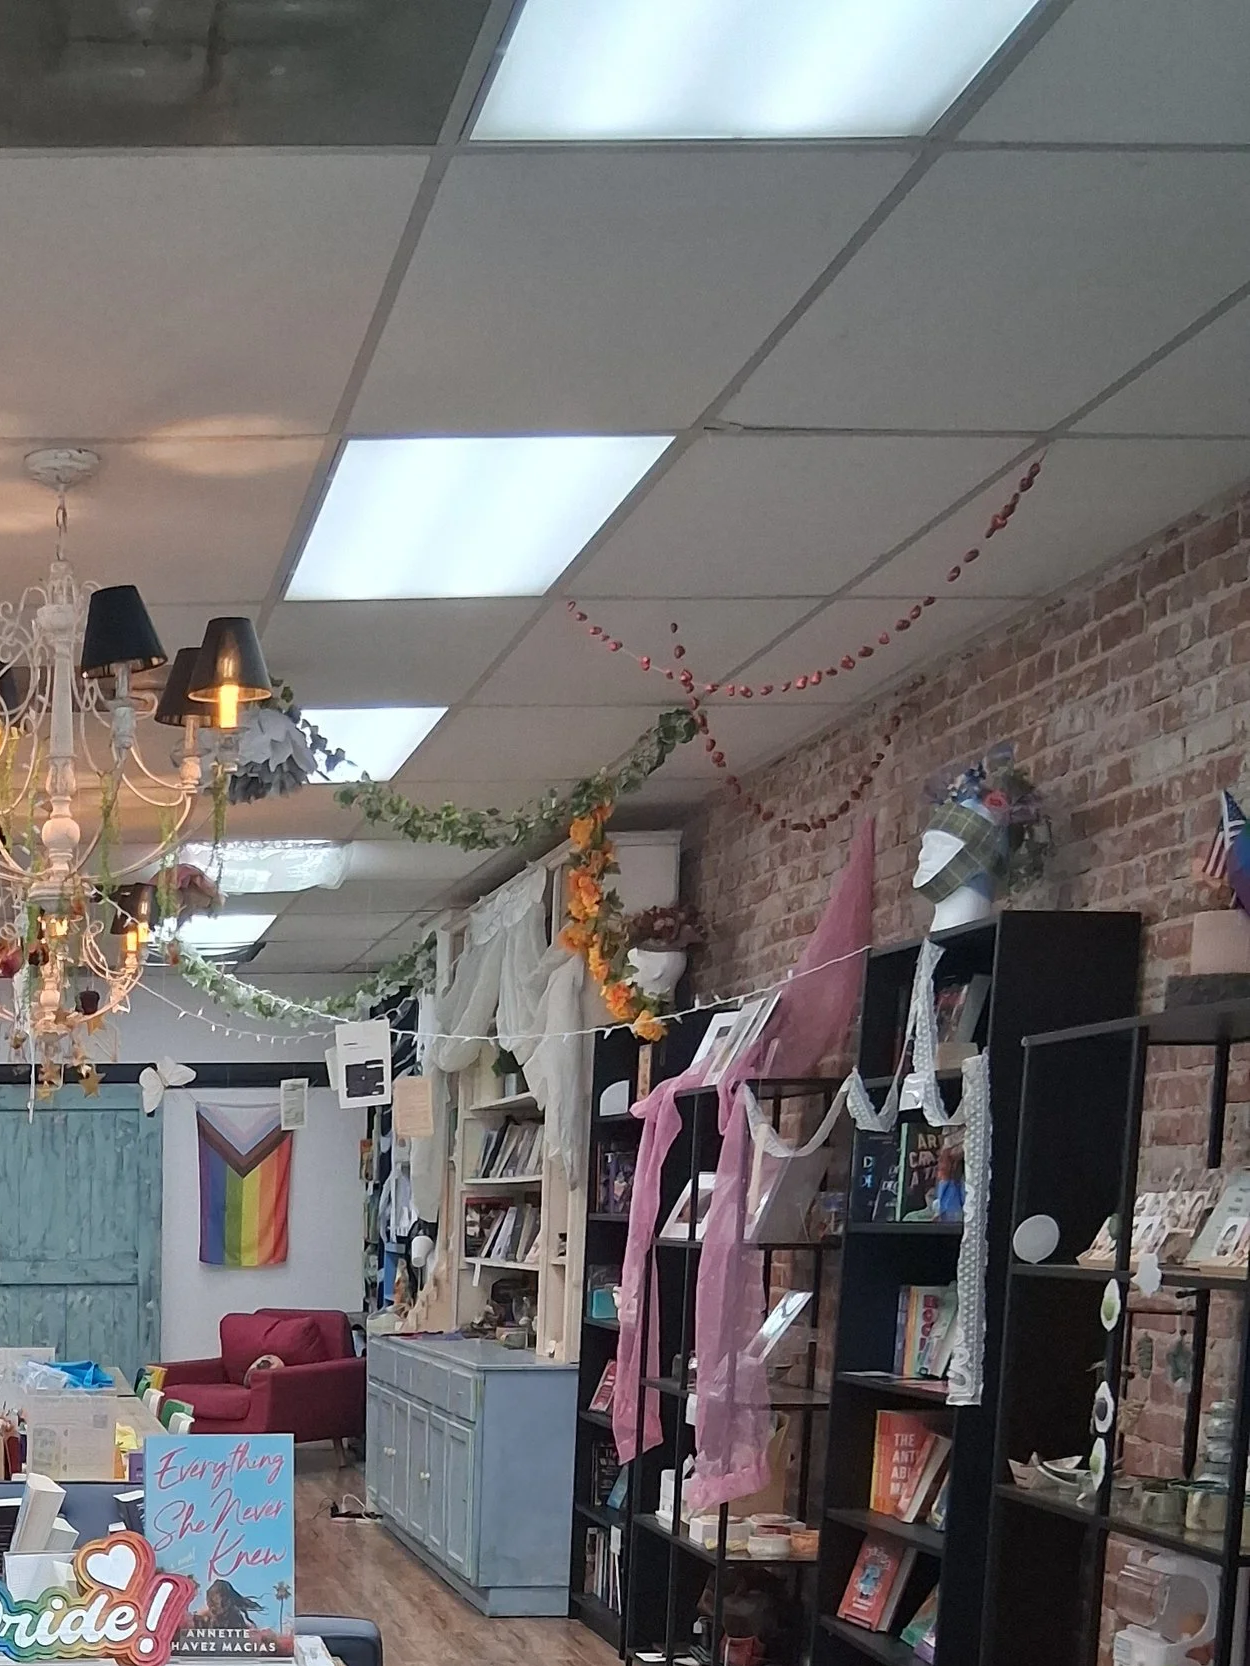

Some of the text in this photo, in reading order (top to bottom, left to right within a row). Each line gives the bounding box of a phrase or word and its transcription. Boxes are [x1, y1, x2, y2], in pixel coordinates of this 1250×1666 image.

[894, 1433, 915, 1447] THE
[153, 1441, 284, 1490] Everything
[153, 1488, 286, 1552] She Never
[208, 1528, 286, 1581] Knew
[171, 1642, 276, 1652] HAVEZ MACIAS
[186, 1629, 250, 1638] ANNETTE
